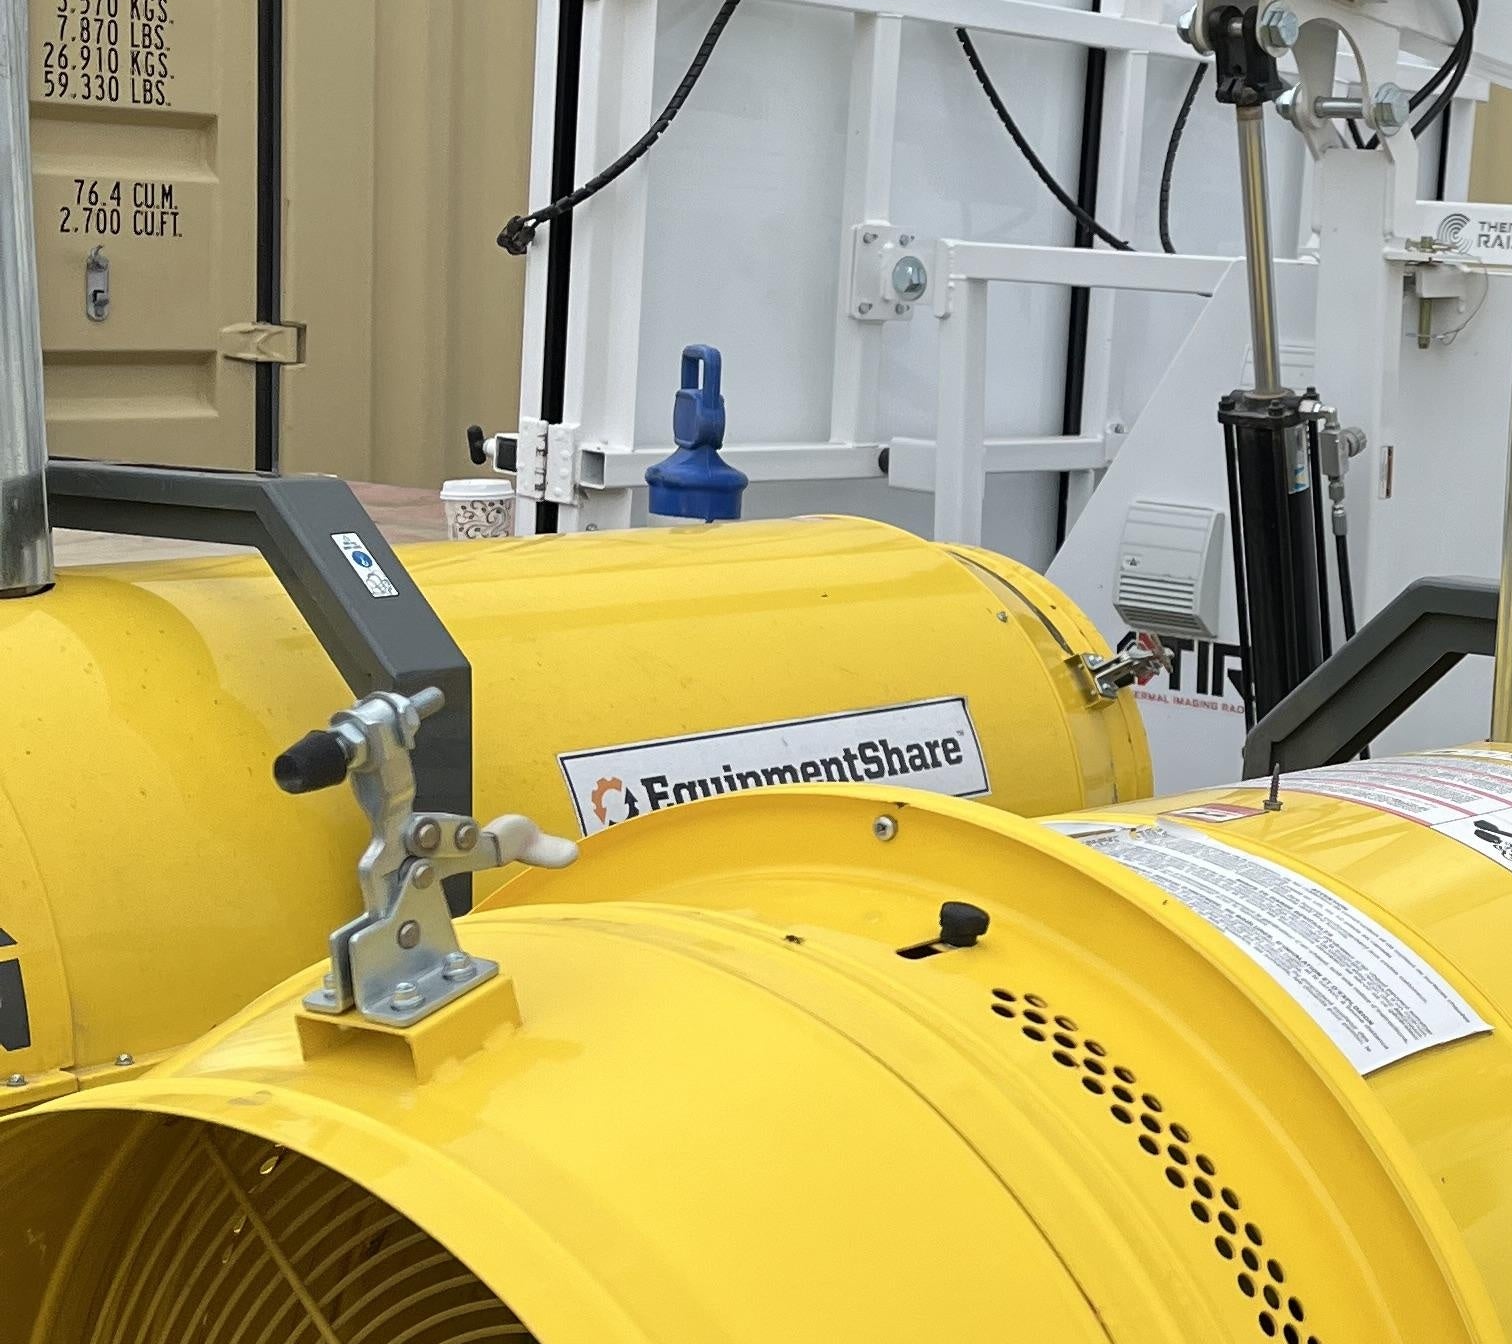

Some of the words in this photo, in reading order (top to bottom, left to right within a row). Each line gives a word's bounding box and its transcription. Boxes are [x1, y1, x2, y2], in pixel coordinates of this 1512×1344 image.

[74, 179, 121, 207] 76.4
[1133, 690, 1170, 705] ERMAL
[1173, 696, 1219, 711] IMAGING
[1221, 703, 1246, 715] RAD
